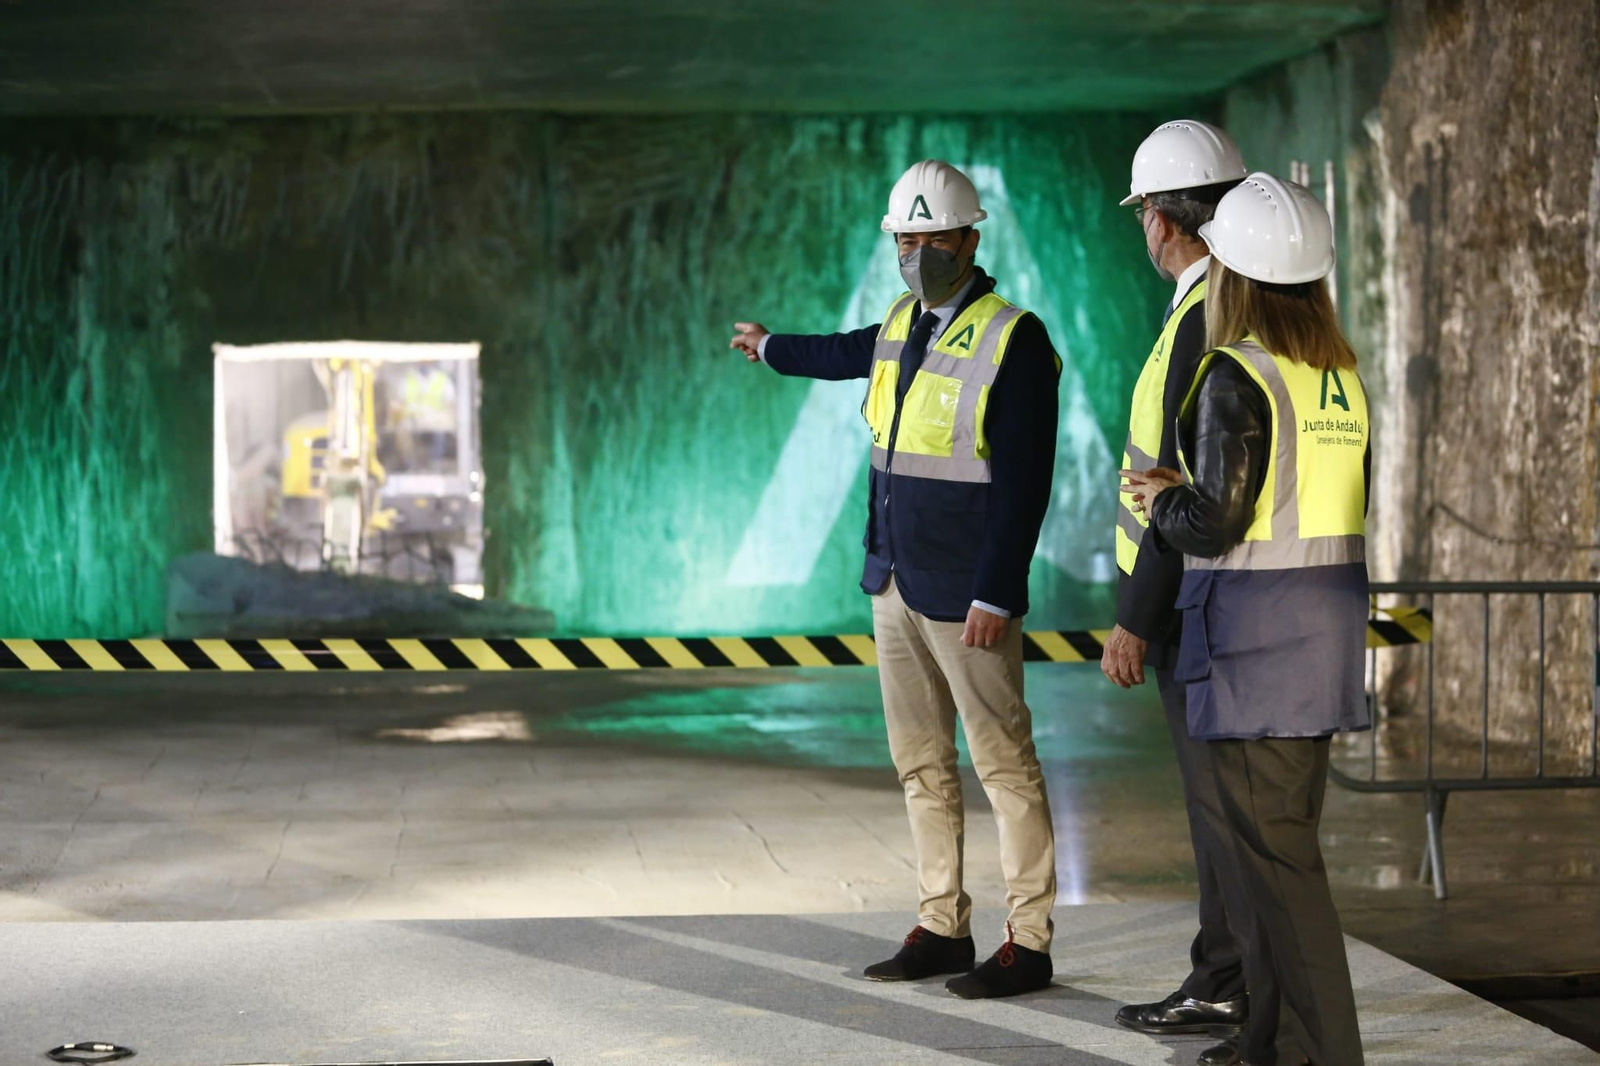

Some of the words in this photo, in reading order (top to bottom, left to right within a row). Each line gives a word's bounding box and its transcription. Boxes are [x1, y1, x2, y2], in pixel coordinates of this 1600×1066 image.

[908, 194, 933, 221] A
[946, 323, 975, 350] A
[1320, 368, 1350, 411] A
[1302, 420, 1324, 432] Junta
[1325, 418, 1334, 431] de
[1343, 436, 1362, 447] Foment
